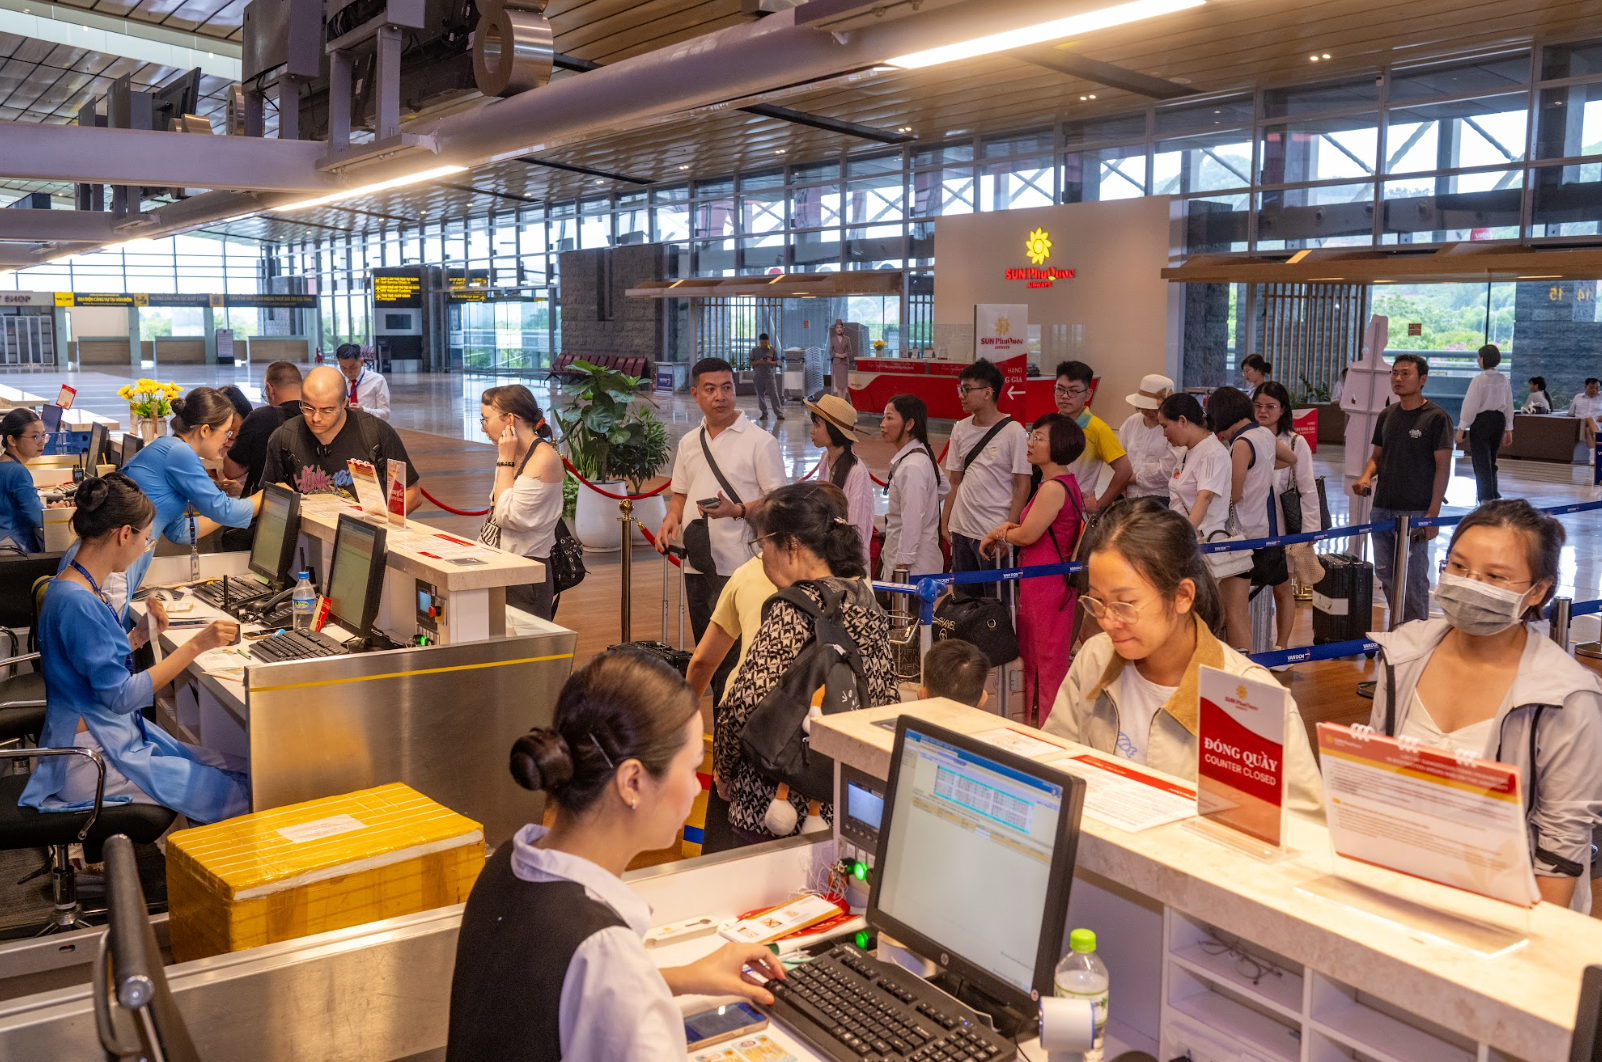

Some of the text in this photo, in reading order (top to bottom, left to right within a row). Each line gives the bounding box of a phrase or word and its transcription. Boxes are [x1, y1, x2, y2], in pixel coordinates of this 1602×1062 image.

[1005, 268, 1026, 280] SUN
[1204, 737, 1278, 772] ĐÓNG QUẦY
[1204, 754, 1276, 786] COUNTER CLOSED
